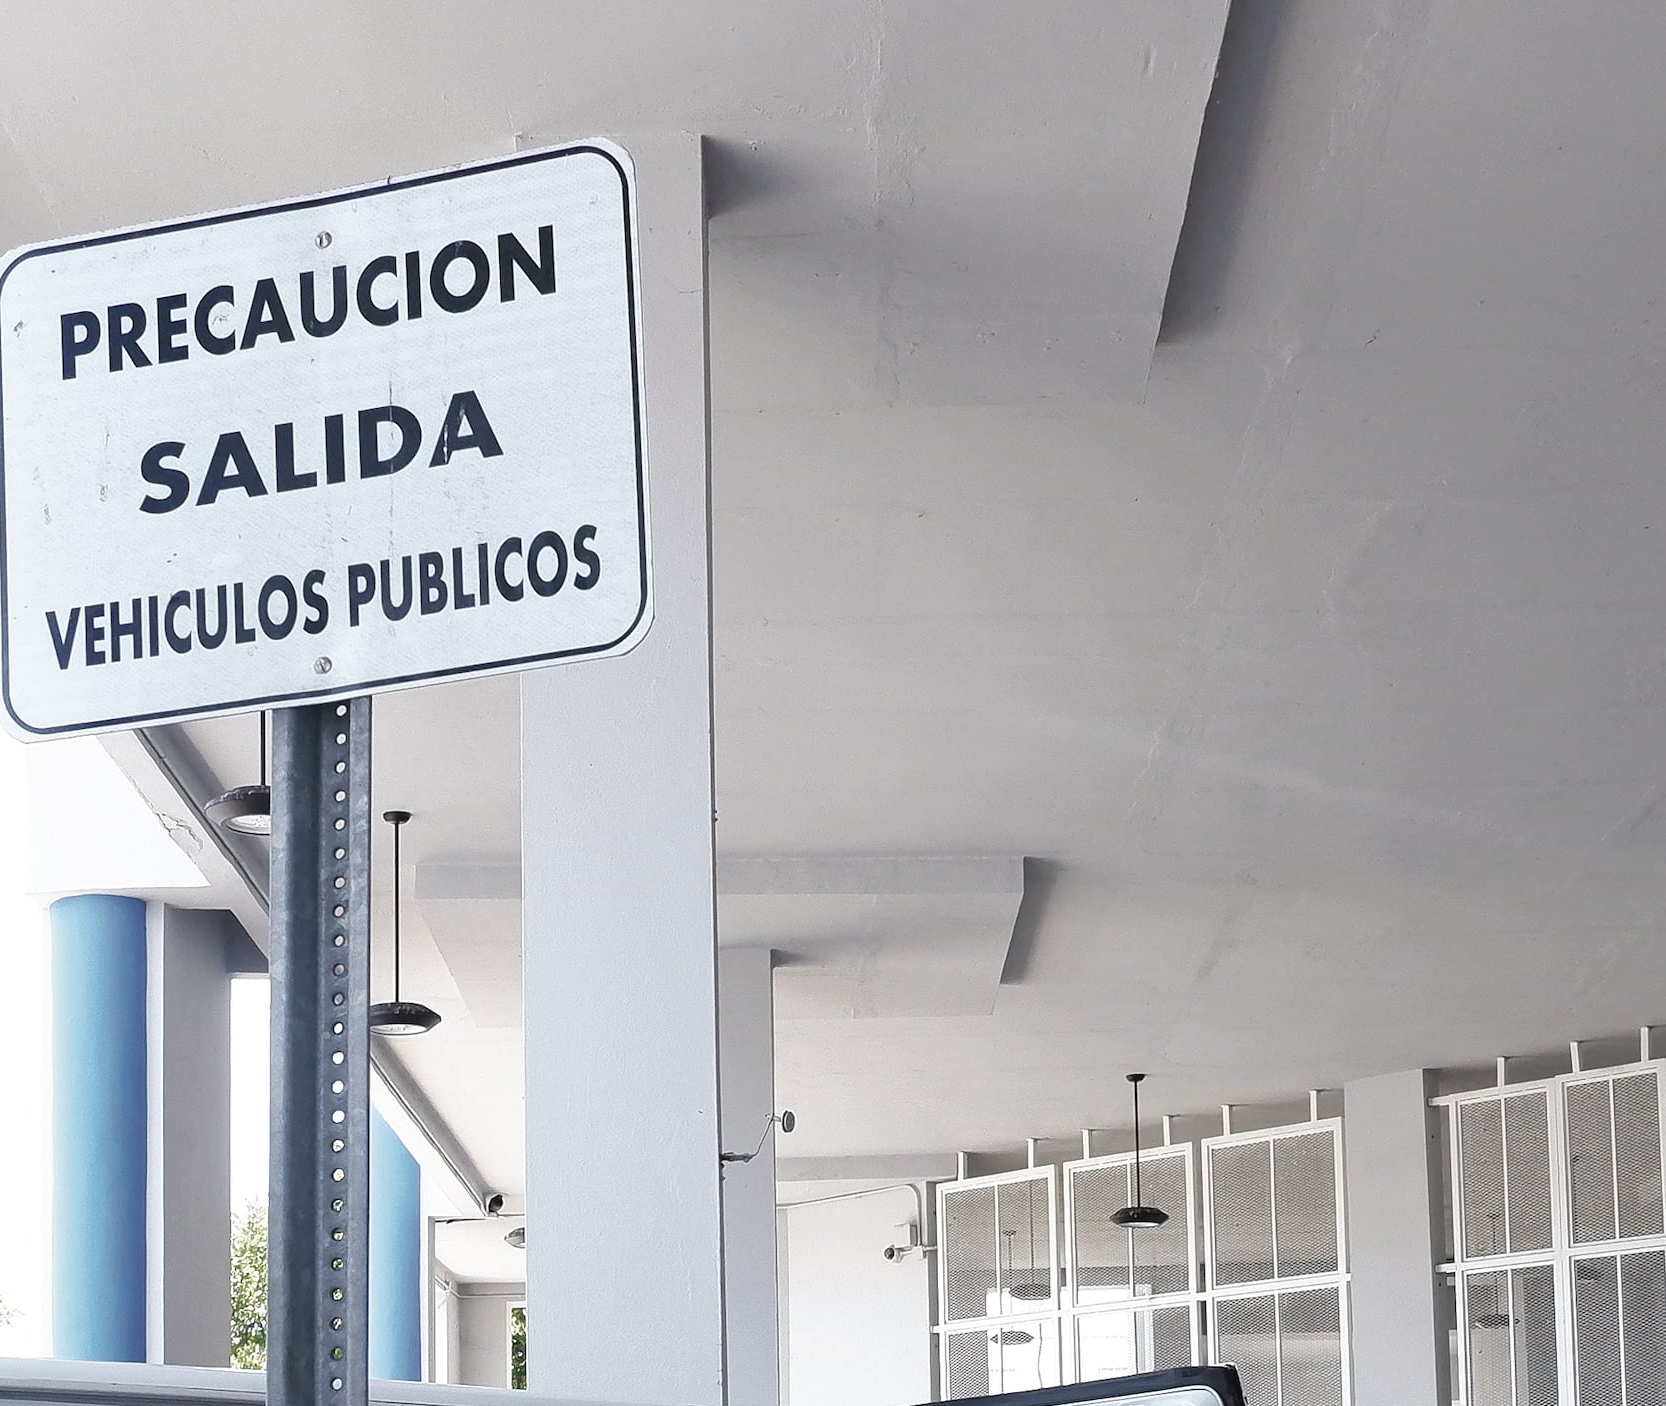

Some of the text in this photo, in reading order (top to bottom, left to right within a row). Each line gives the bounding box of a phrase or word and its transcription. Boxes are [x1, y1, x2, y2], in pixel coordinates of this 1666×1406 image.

[60, 224, 556, 381] PRECAUCION
[139, 390, 504, 514] SALIDA
[45, 524, 601, 670] VEHICULOS PUBLICOS
